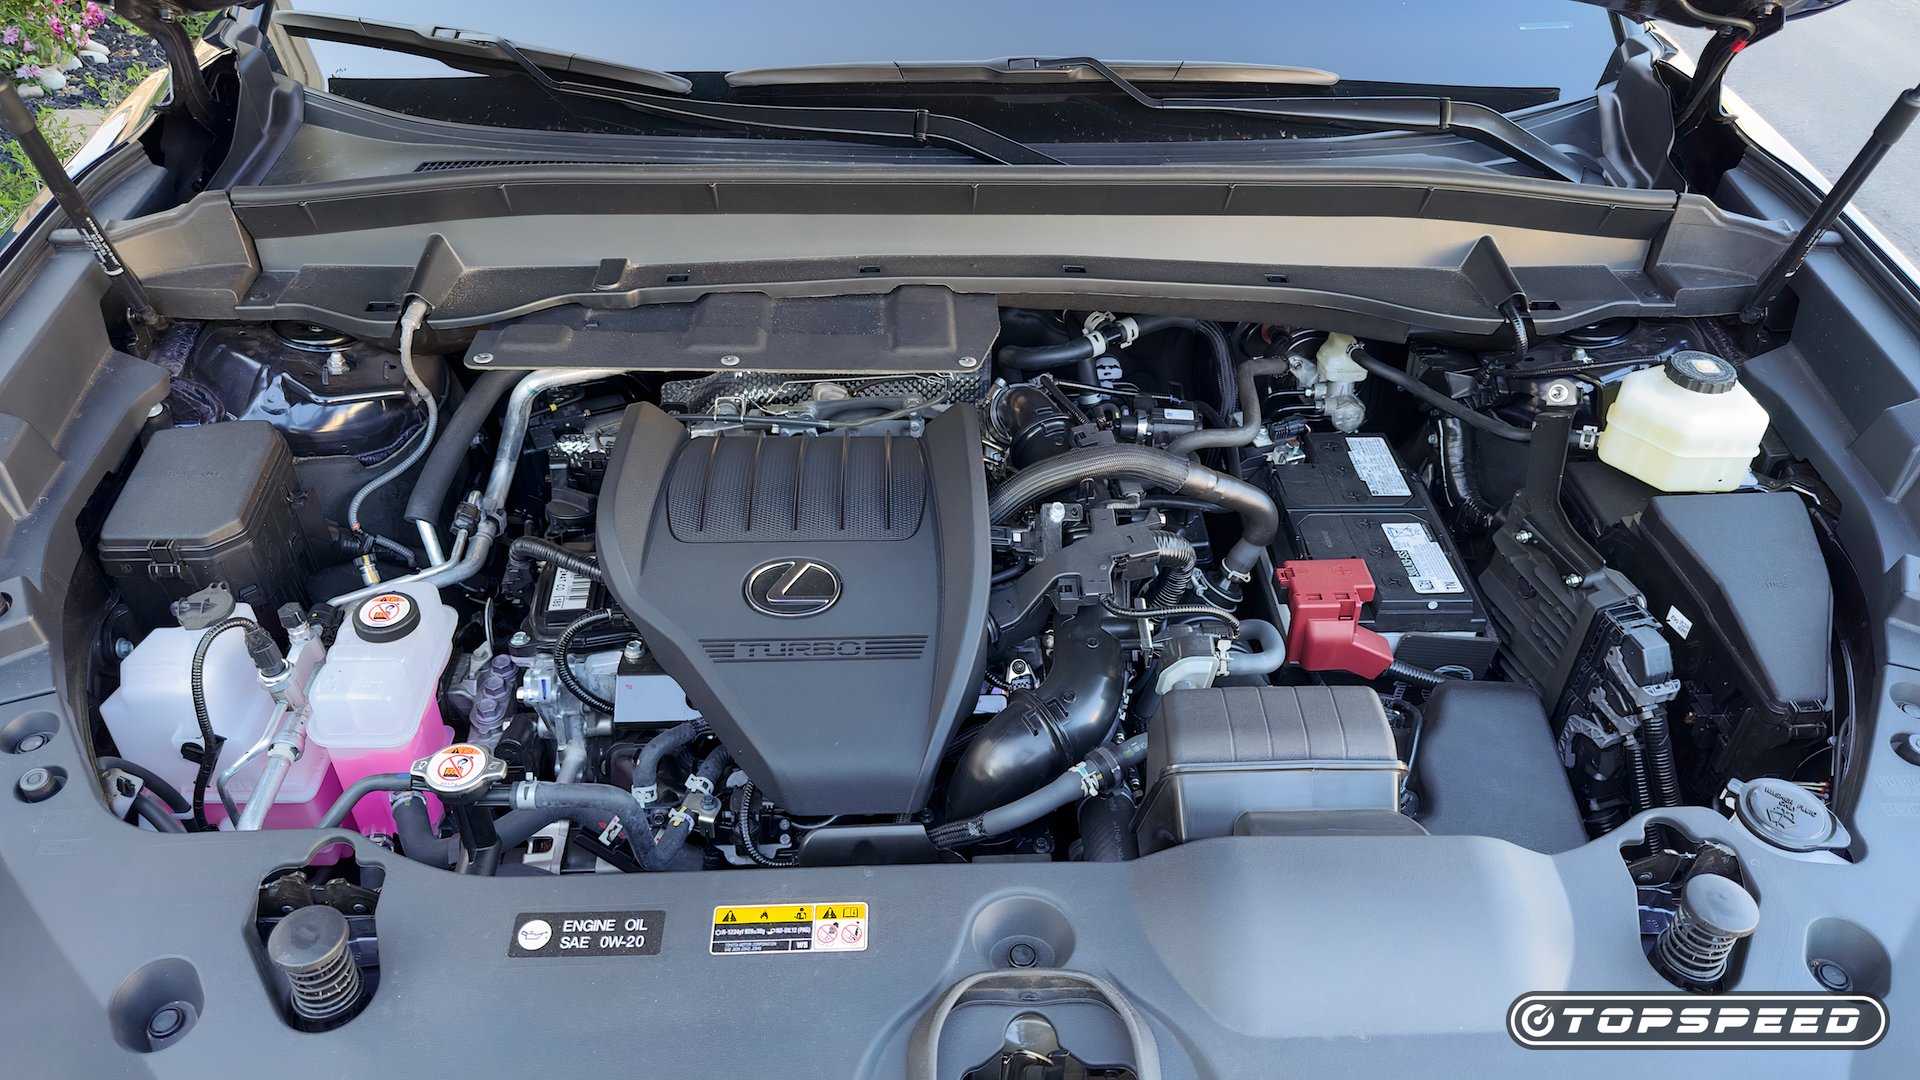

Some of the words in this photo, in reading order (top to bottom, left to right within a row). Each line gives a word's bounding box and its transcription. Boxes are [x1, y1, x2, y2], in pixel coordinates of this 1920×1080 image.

[739, 640, 861, 658] TURBO
[562, 919, 617, 933] ENGINE
[624, 918, 648, 931] OIL
[559, 936, 592, 949] SAE
[600, 935, 645, 948] 0W-20
